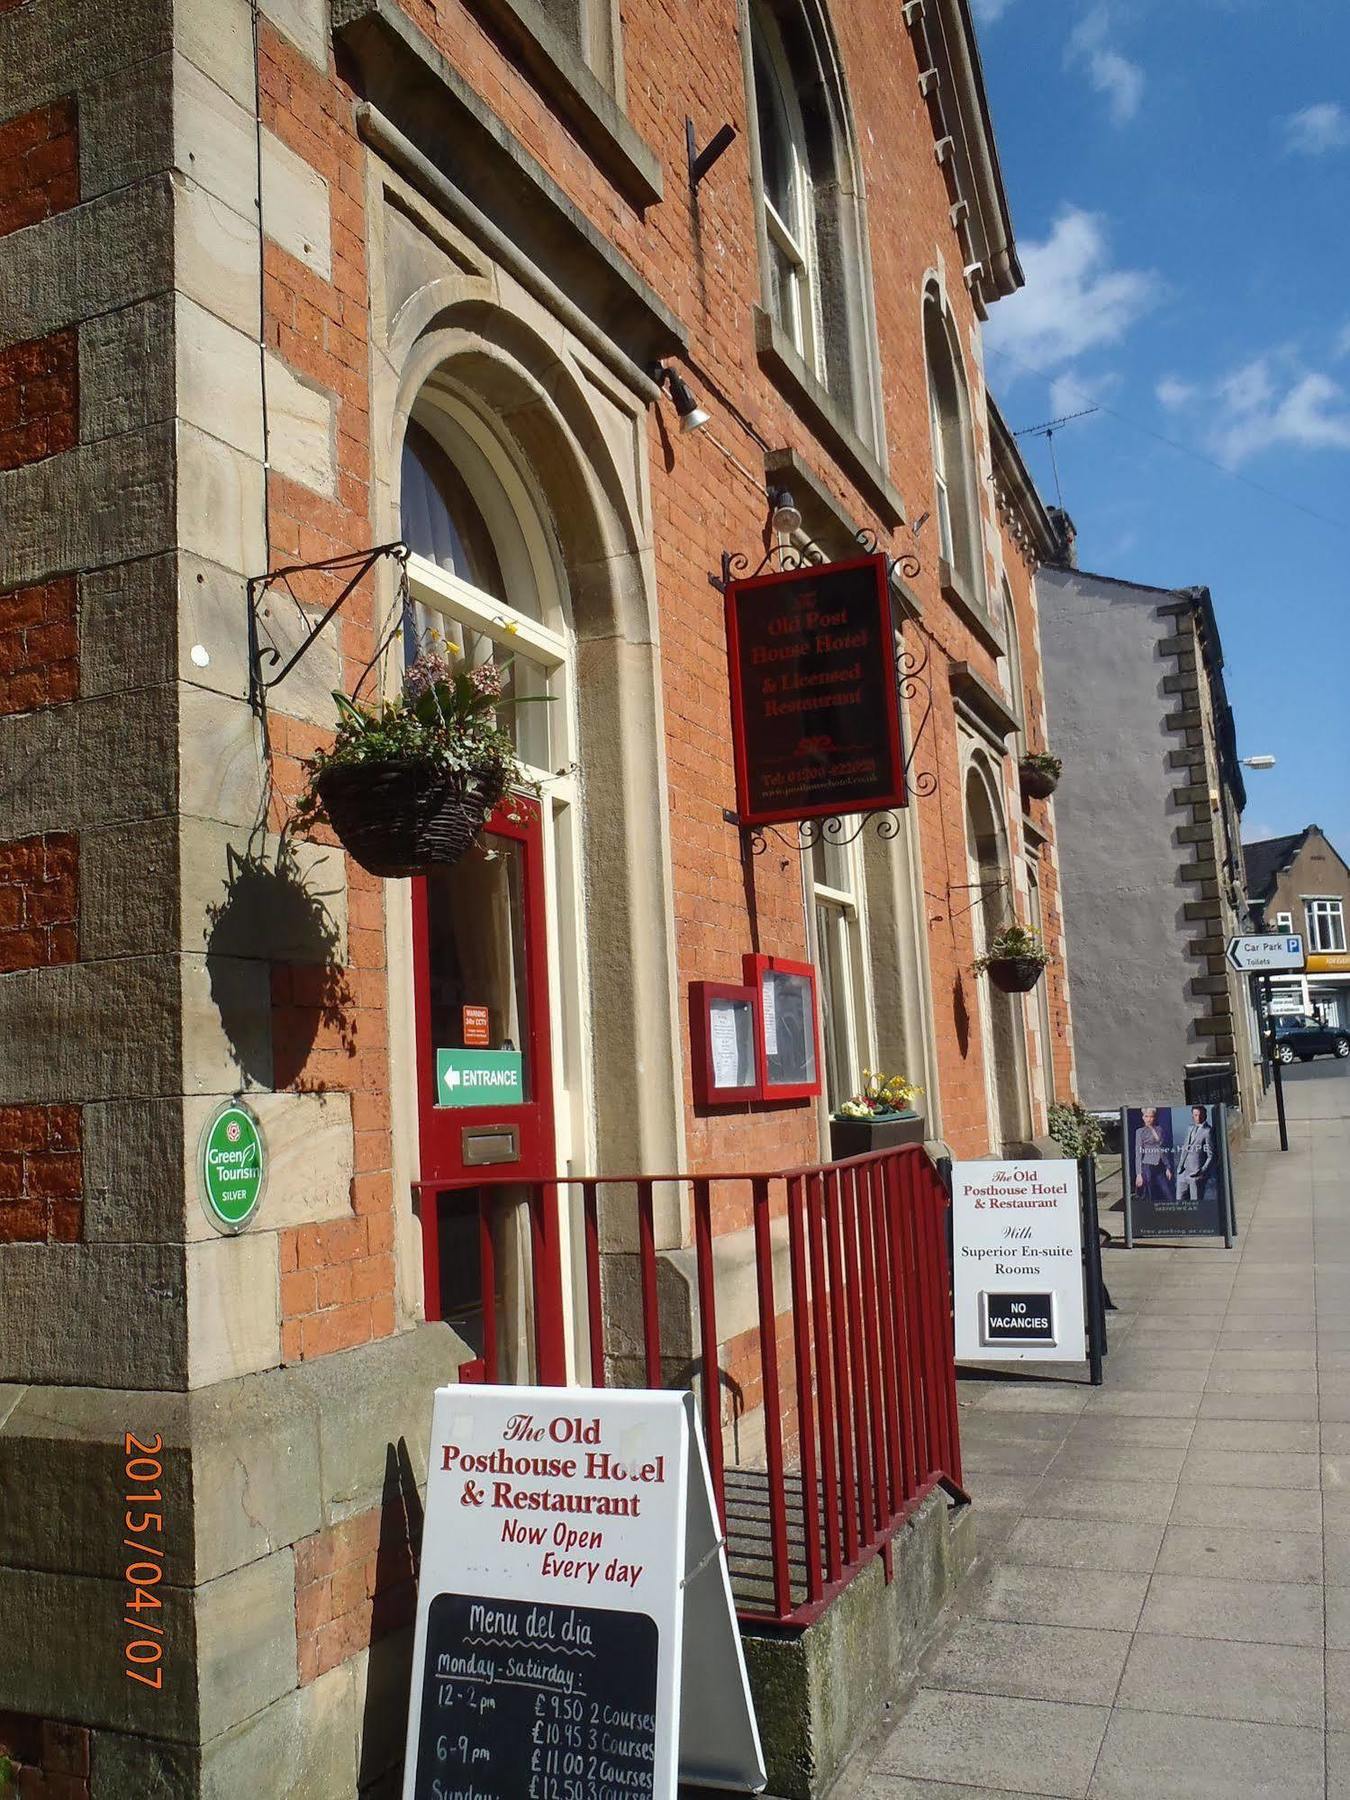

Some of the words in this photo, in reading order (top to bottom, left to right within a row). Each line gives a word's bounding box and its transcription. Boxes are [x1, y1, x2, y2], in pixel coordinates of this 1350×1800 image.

[806, 610, 848, 629] Post
[752, 641, 810, 664] House
[817, 631, 868, 655] Hotel
[762, 679, 779, 695] &
[783, 664, 862, 691] Licensed
[764, 691, 861, 717] Restaurant
[1244, 943, 1260, 952] Car
[1263, 942, 1282, 951] Park
[1246, 958, 1270, 966] Toilets
[462, 1070, 518, 1086] ENTRANCE
[209, 1149, 243, 1164] Green
[217, 1166, 260, 1182] Tourism
[992, 1171, 1012, 1182] The
[1014, 1170, 1037, 1181] Old
[222, 1190, 246, 1202] SILVER
[964, 1185, 1028, 1196] Posthouse
[1031, 1183, 1068, 1195] Hotel
[974, 1199, 986, 1209] &
[989, 1198, 1058, 1209] Restaurant
[1001, 1225, 1034, 1240] With
[960, 1245, 1018, 1260] Superior
[1021, 1245, 1073, 1258] En-suite
[995, 1263, 1040, 1275] Rooms
[1010, 1302, 1026, 1314] NO
[990, 1317, 1048, 1329] VACANCIES
[503, 1414, 545, 1442] The
[548, 1417, 601, 1445] Old
[440, 1445, 577, 1479] Posthouse
[584, 1452, 665, 1483] Hoel
[460, 1480, 484, 1508] &
[491, 1482, 641, 1517] Restaurant
[501, 1519, 548, 1545] Now
[553, 1523, 603, 1553] Open
[541, 1552, 598, 1585] Every
[605, 1559, 643, 1588] day
[470, 1604, 519, 1636] Menu
[526, 1607, 555, 1638] del
[562, 1610, 592, 1645] dia
[480, 1697, 496, 1715] pm
[590, 1703, 600, 1724] 2
[603, 1705, 656, 1733] Courses
[531, 1719, 582, 1748] £10.95
[588, 1728, 597, 1751] 3
[601, 1733, 655, 1761] Courses
[471, 1747, 490, 1766] pm
[587, 1756, 596, 1781] 2
[599, 1761, 653, 1789] Courses
[588, 1781, 597, 1800] 3
